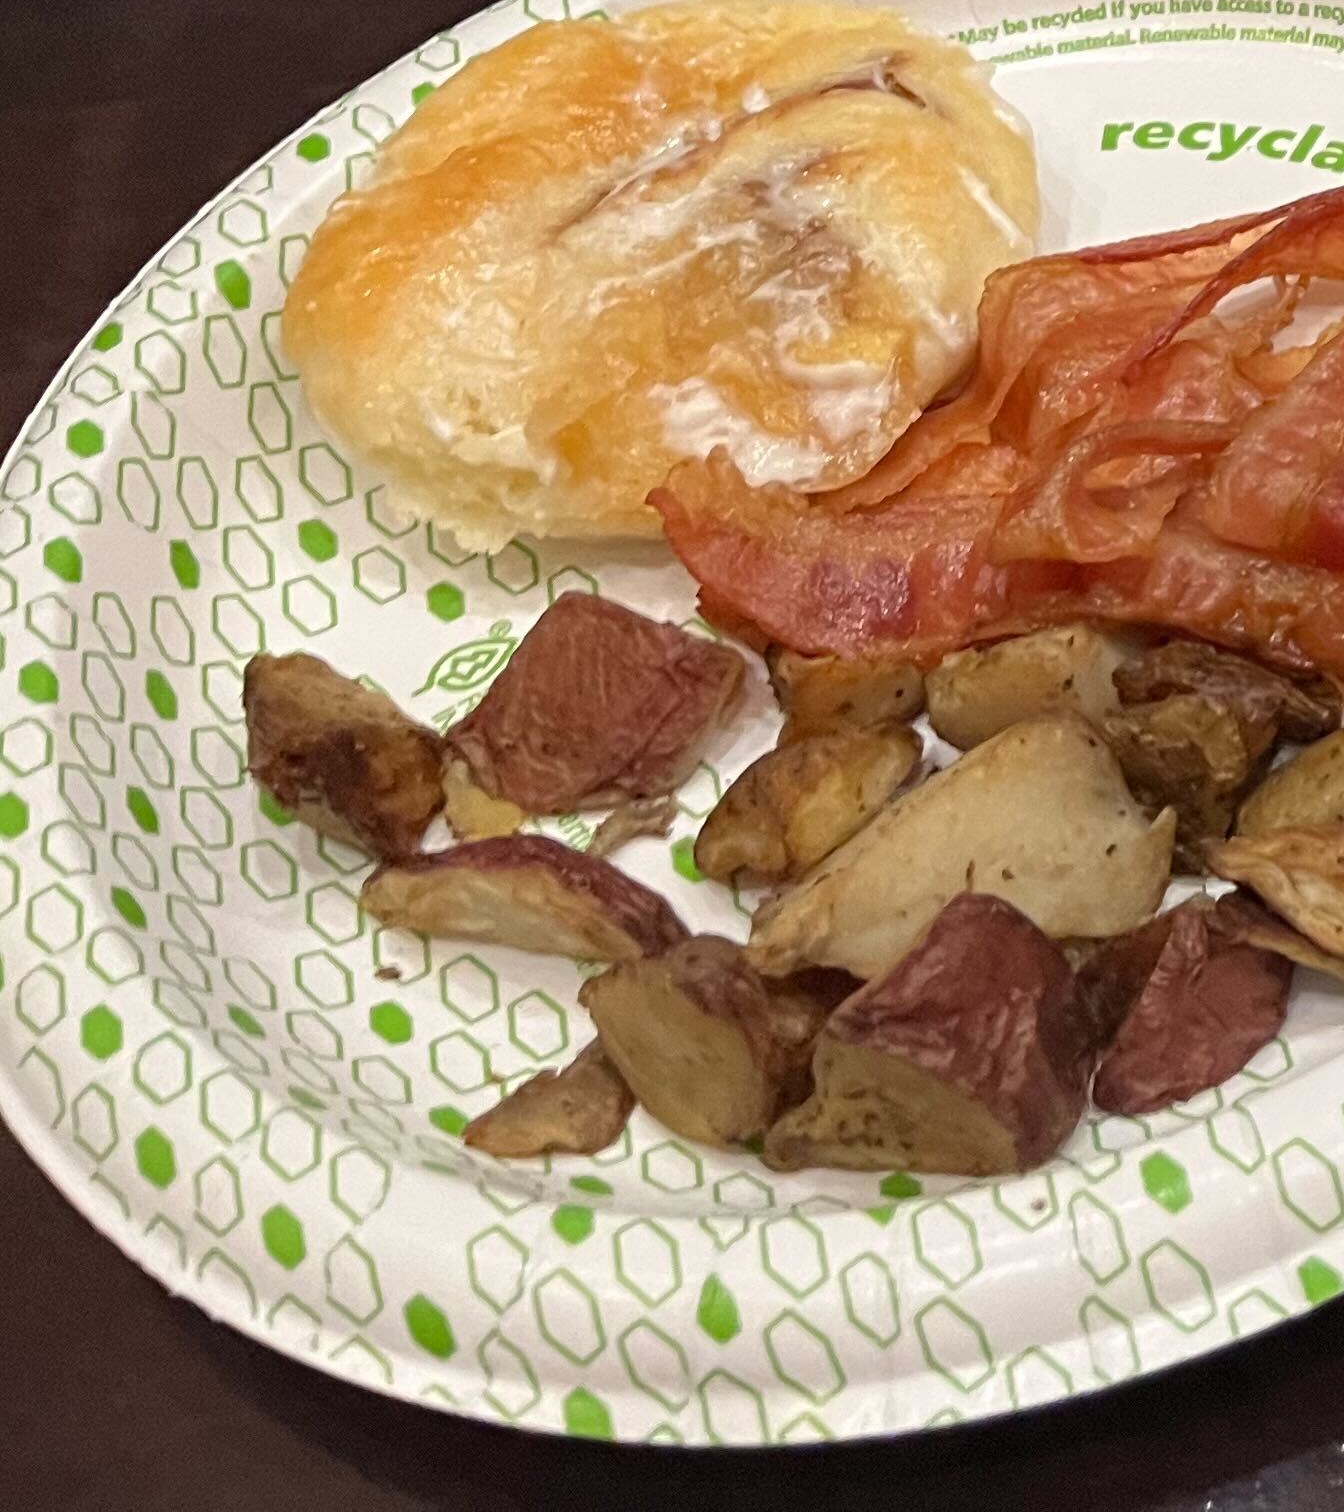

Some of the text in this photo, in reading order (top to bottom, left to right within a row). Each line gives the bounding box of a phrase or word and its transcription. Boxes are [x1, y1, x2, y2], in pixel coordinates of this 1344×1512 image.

[1002, 19, 1028, 36] be
[1130, 0, 1165, 20] you
[1276, 0, 1295, 15] to
[1298, 2, 1310, 17] a
